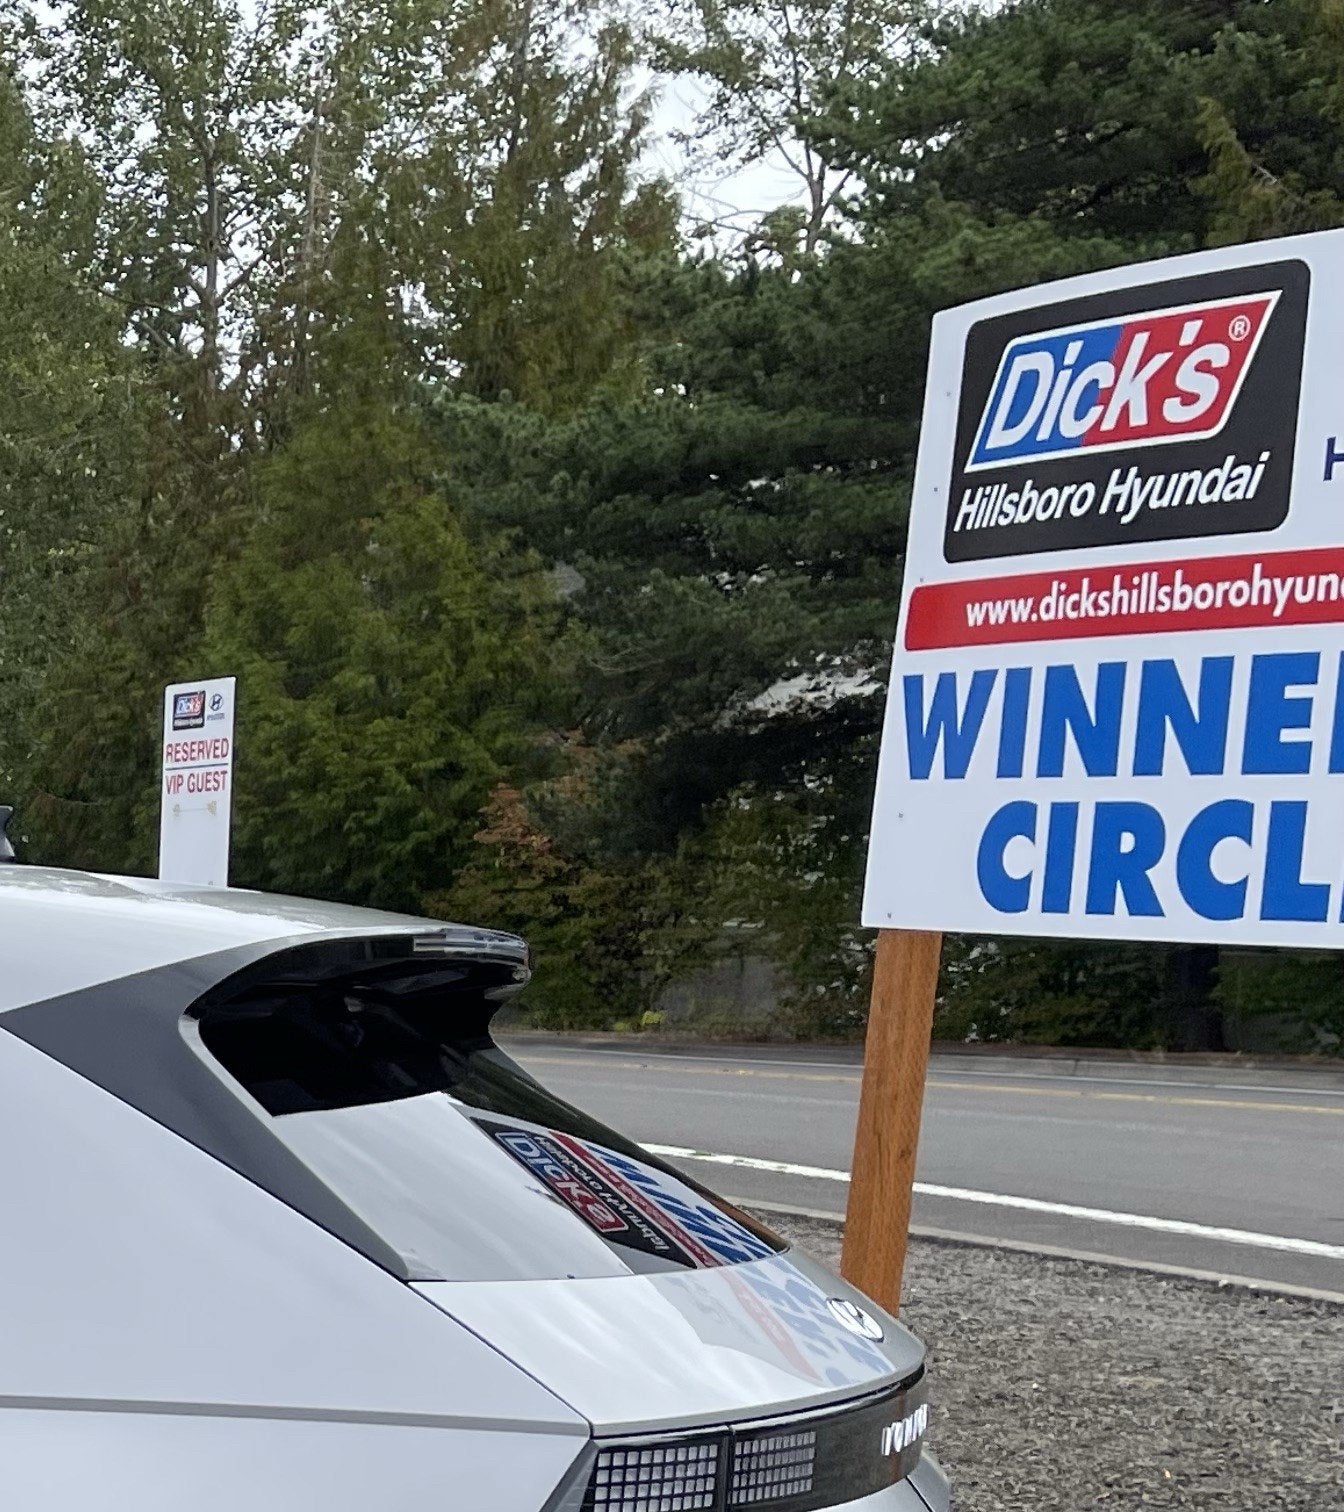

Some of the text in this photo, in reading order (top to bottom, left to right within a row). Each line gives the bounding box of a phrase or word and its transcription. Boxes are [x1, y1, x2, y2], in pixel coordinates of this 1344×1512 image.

[952, 450, 1272, 533] Hillsboro Hyundai
[965, 562, 1344, 628] www.dickshillsborohyun
[165, 737, 229, 763] RESERVED
[902, 650, 1344, 780] WINNE
[165, 769, 228, 795] VIP GUEST
[976, 798, 1344, 924] CIRCL
